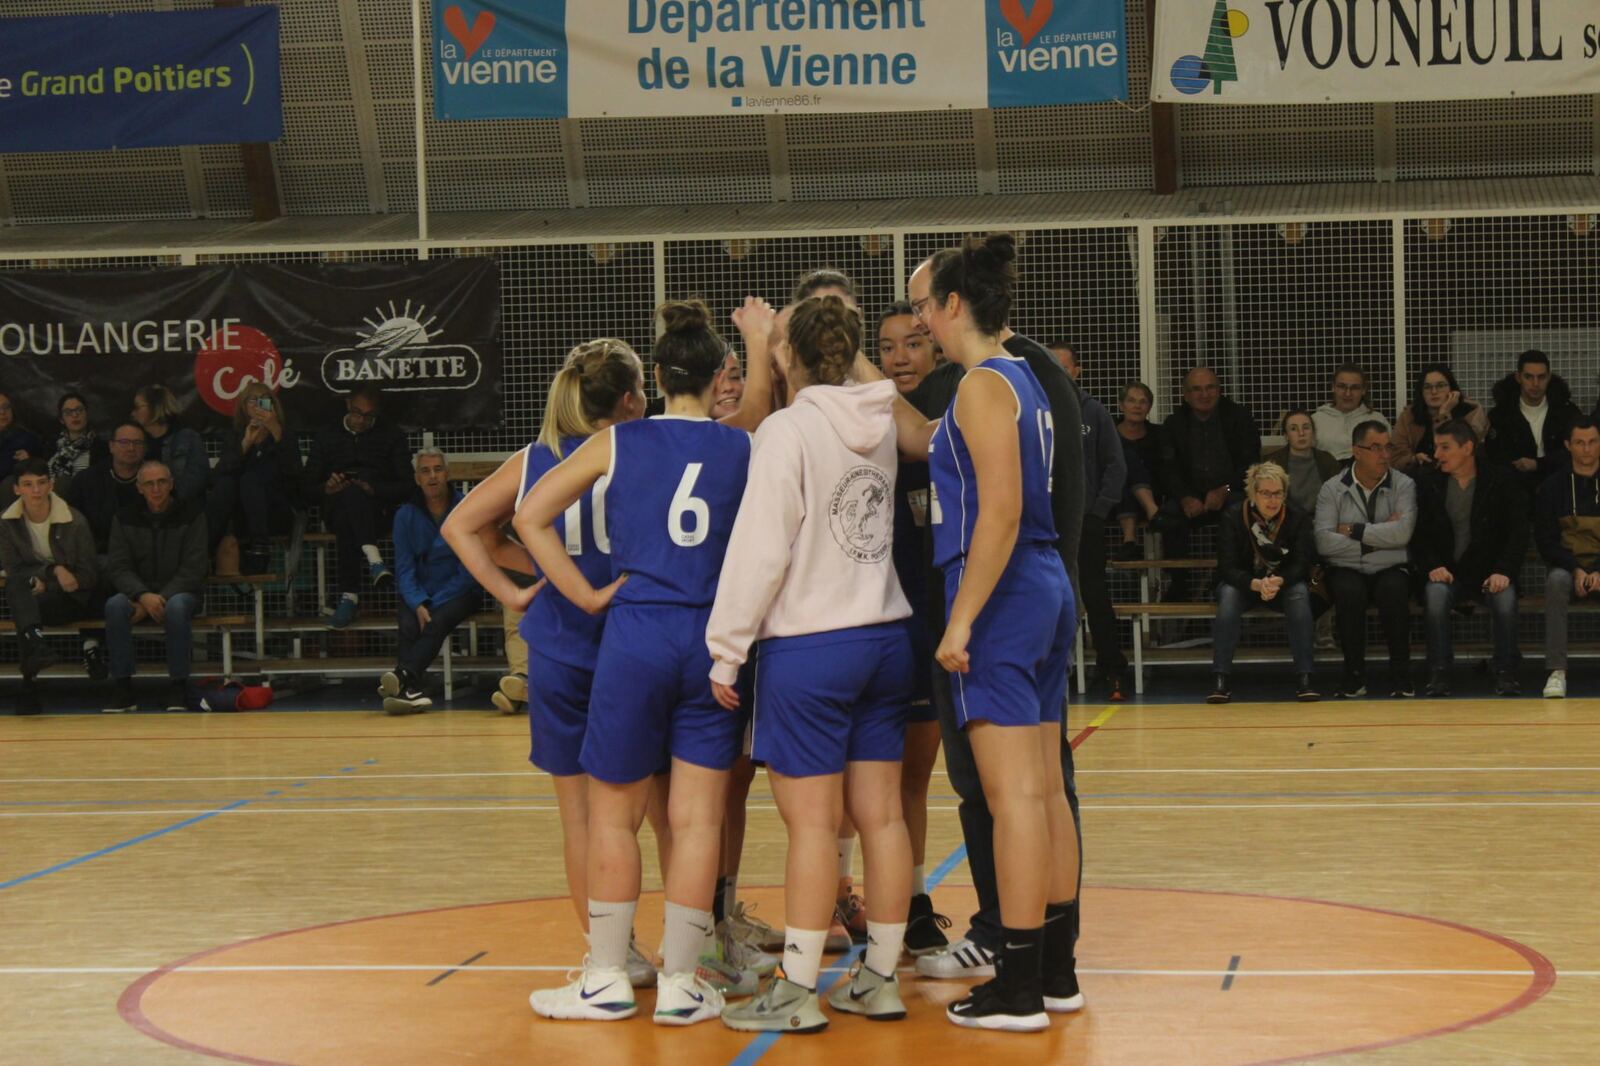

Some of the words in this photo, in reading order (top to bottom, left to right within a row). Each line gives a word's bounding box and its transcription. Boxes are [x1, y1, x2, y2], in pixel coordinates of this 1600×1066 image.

[996, 27, 1014, 47] la
[1040, 35, 1051, 44] LE
[1264, 0, 1563, 71] VOUNEUIL
[1583, 23, 1600, 59] s
[440, 40, 457, 59] la
[481, 49, 492, 58] LE
[998, 42, 1118, 73] vienne
[441, 60, 557, 84] vienne
[637, 47, 690, 90] de
[706, 46, 745, 88] la
[760, 44, 917, 87] Vienne
[20, 68, 104, 96] Grand
[113, 64, 232, 93] Poitiers
[745, 94, 822, 107] lavienne86.fr
[0, 318, 242, 355] OULANGERIE
[336, 356, 467, 380] BANETTE
[667, 462, 710, 547] 6
